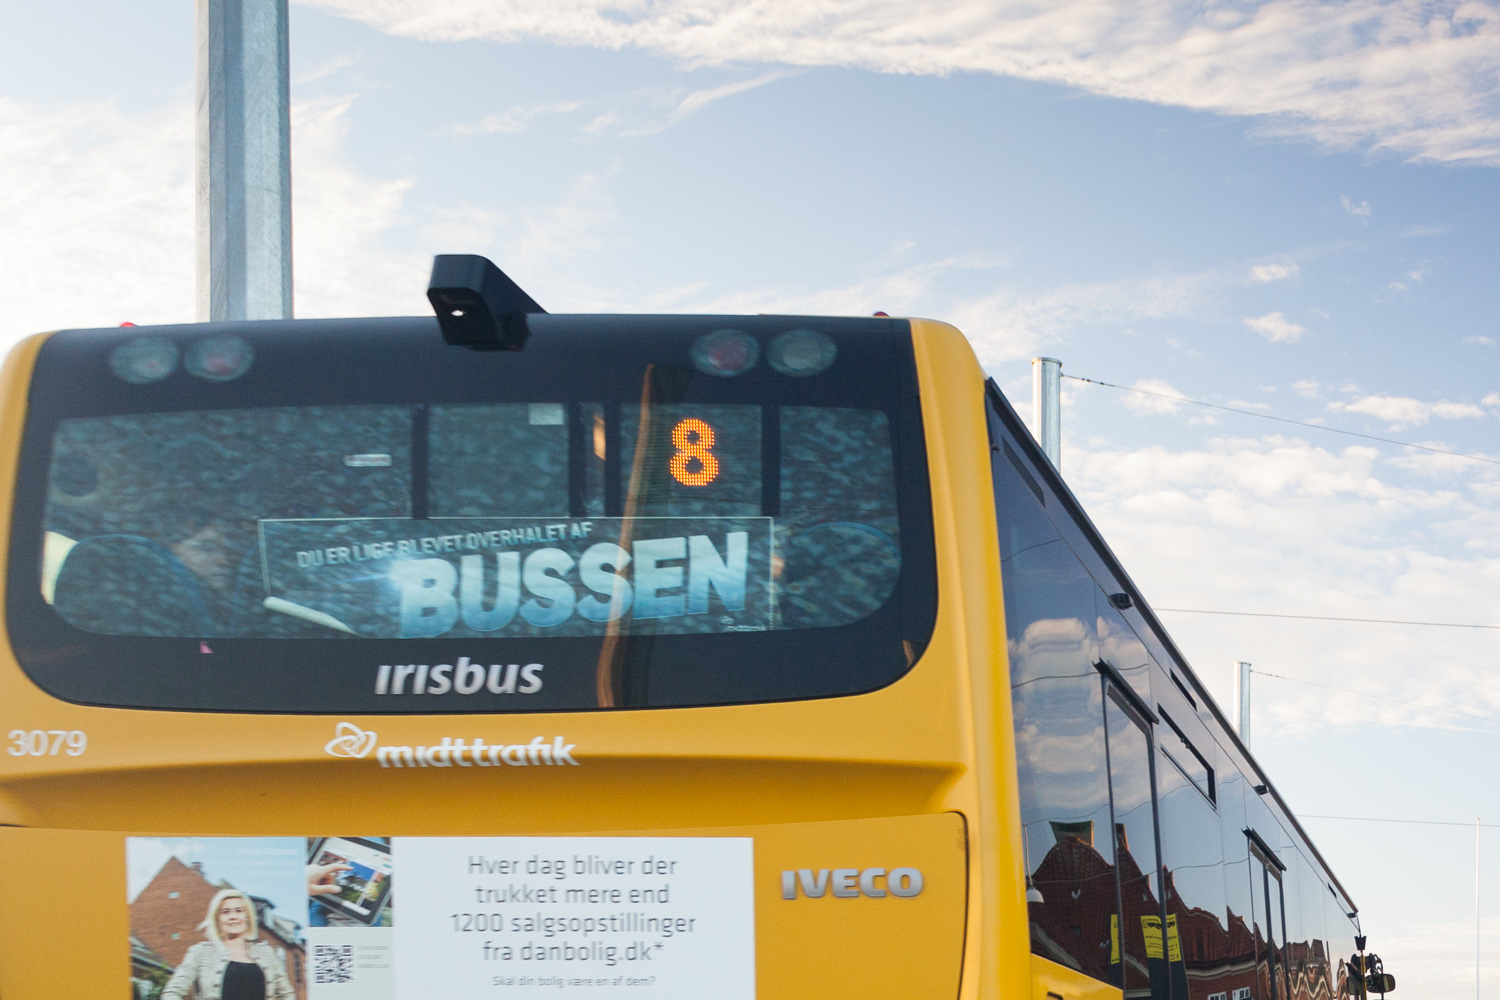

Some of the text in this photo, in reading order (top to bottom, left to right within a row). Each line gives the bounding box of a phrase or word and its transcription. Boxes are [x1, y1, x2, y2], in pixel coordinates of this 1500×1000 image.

[670, 419, 719, 486] 8
[297, 521, 593, 568] DU ER LIGE BLEVET OVERHALET AF
[397, 531, 749, 639] BUSSEN
[374, 656, 545, 695] irisbus
[6, 729, 88, 757] 3079
[377, 735, 580, 768] midttrafik
[467, 855, 677, 880] Hver dag bliver der
[475, 884, 670, 903] trukket mere end
[781, 867, 924, 901] IVECO
[450, 912, 696, 937] 1200 salgsopstillinger
[482, 940, 513, 961] fra
[493, 975, 516, 986] Skal
[518, 975, 535, 986] din
[538, 975, 564, 989] bolig
[596, 978, 610, 986] en
[612, 975, 623, 986] af
[625, 975, 657, 986] dem?
